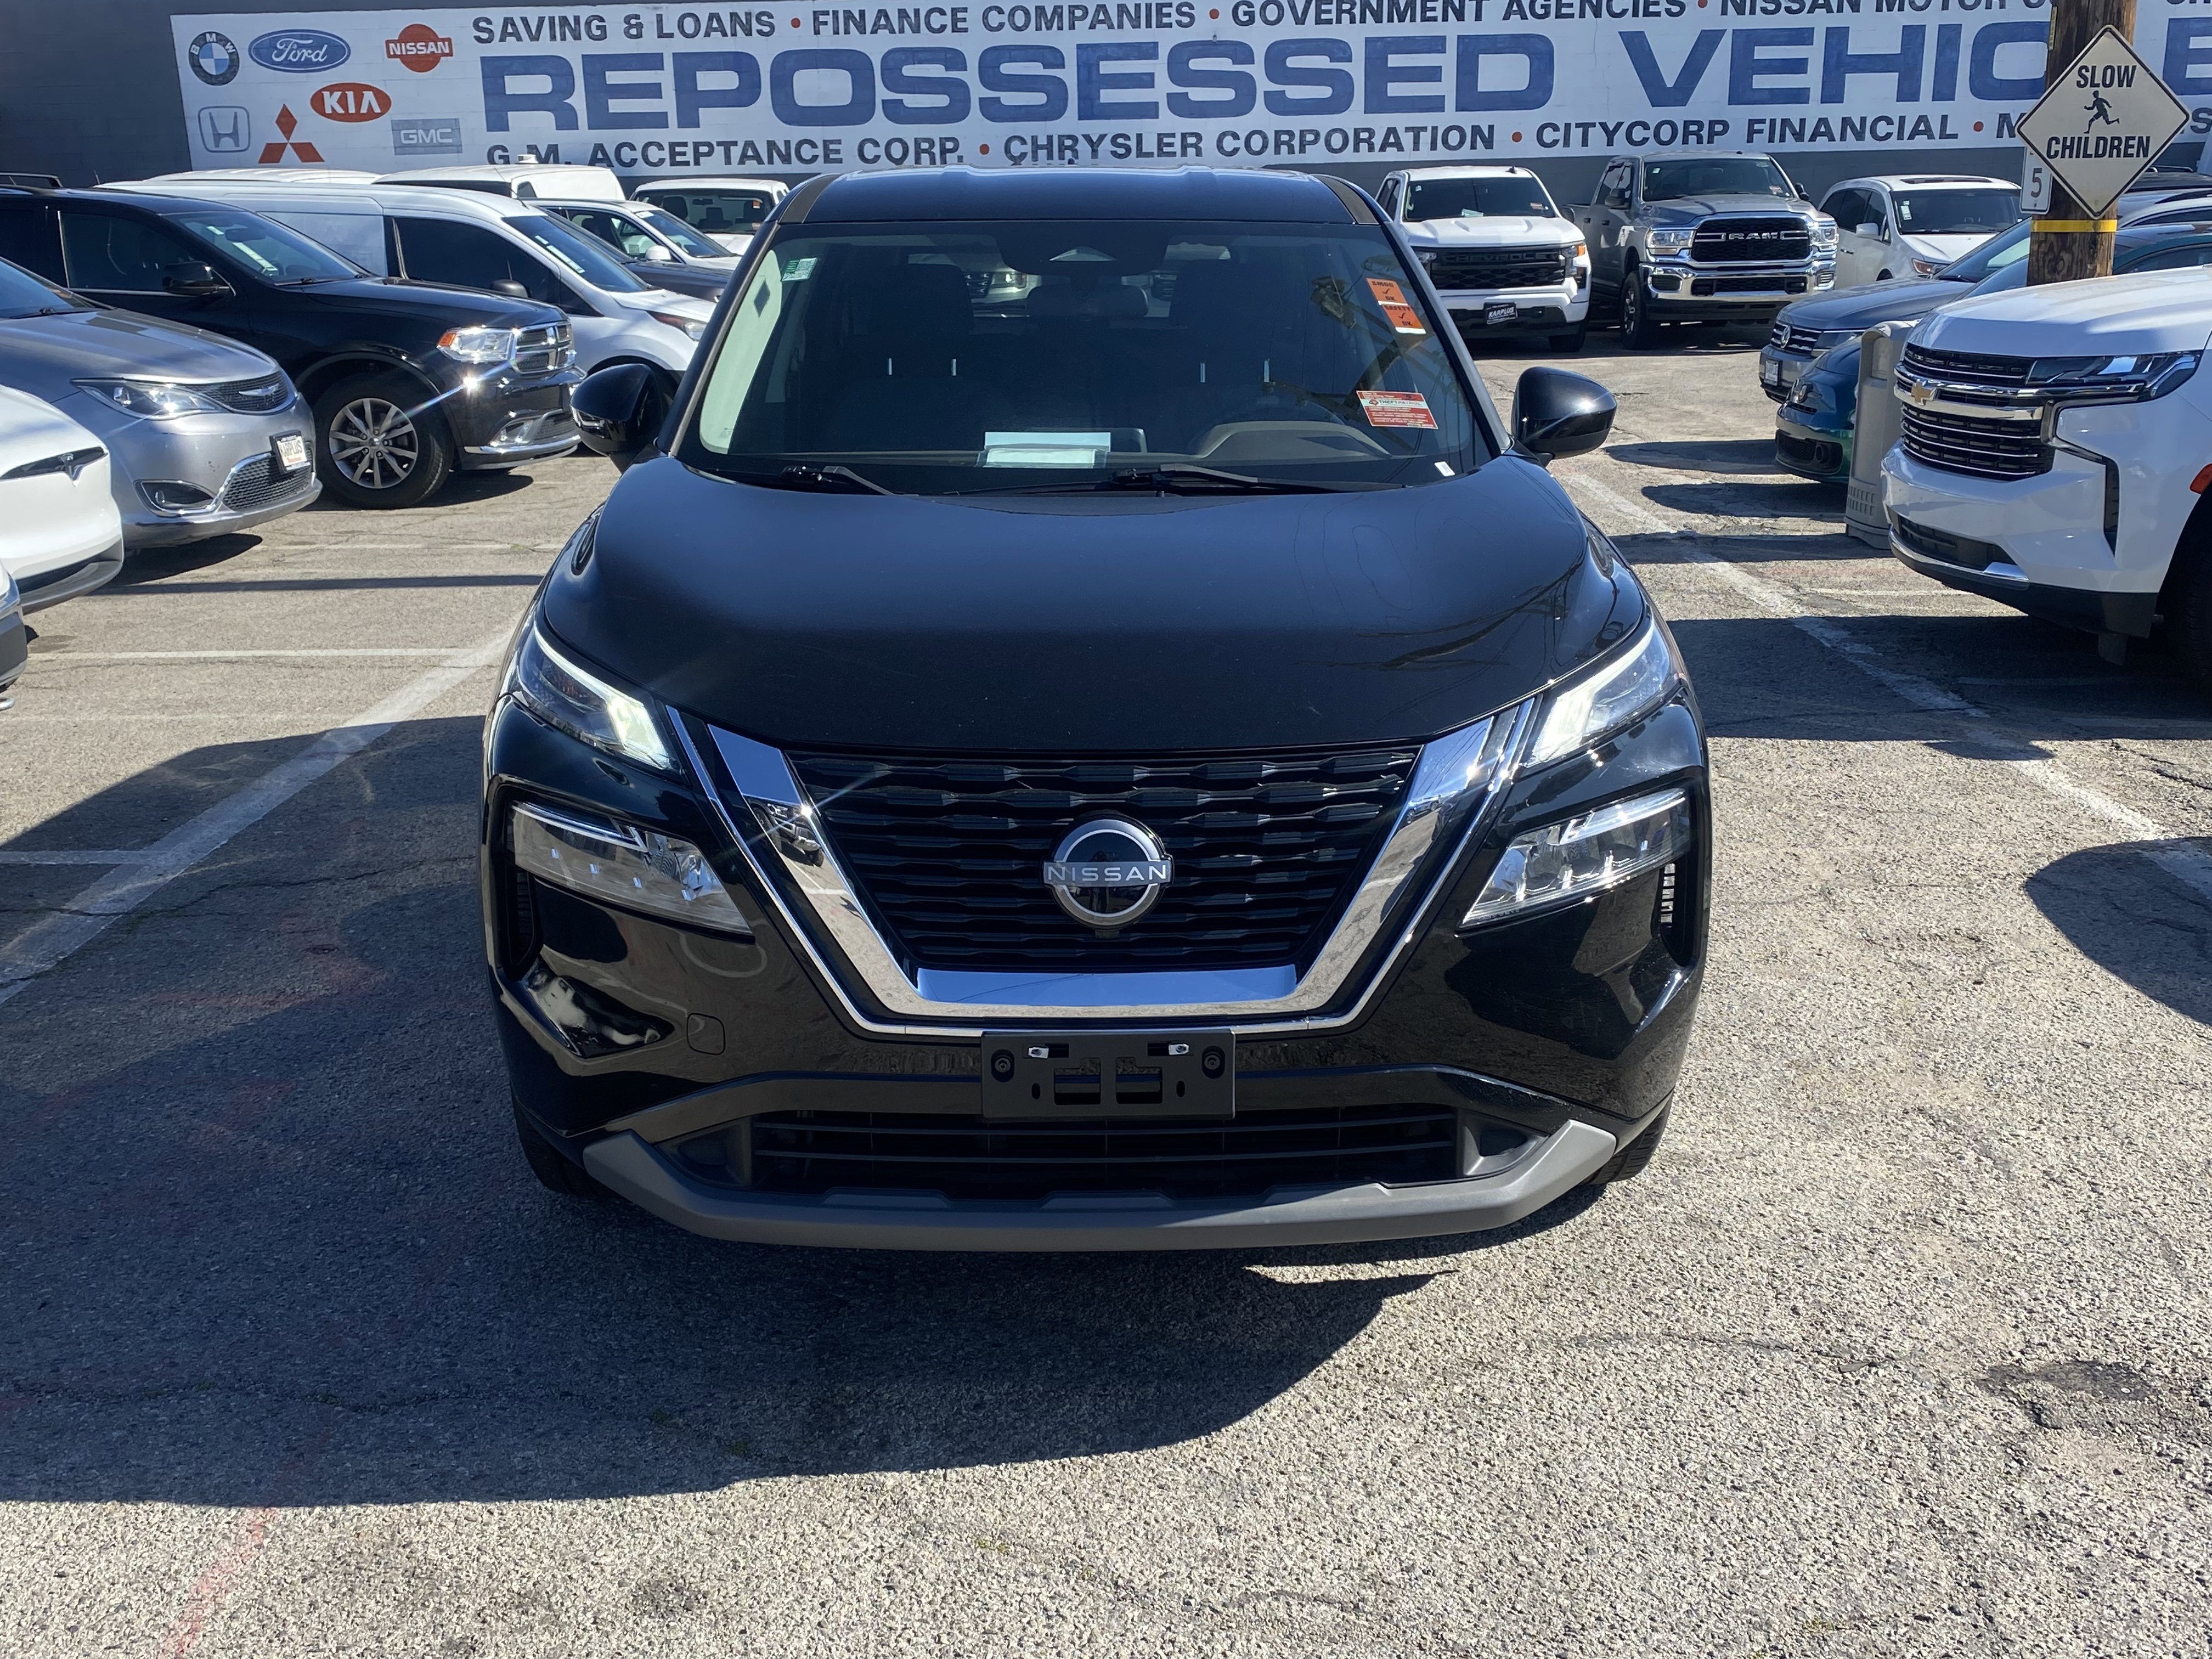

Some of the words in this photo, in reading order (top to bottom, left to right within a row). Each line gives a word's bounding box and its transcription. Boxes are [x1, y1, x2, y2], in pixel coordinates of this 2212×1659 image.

[472, 15, 607, 44] SAVING
[623, 14, 644, 39] &
[658, 11, 776, 39] LOANS
[812, 7, 969, 36] FINANCE
[982, 1, 1196, 33] COMPANIES
[1231, 0, 1486, 26] GOVERNMENT
[1503, 0, 1687, 20] AGENCIES
[190, 33, 236, 55] BMW
[272, 38, 328, 62] Ford
[389, 41, 449, 55] NISSAN
[481, 33, 1554, 132] REPOSSESSED
[2076, 65, 2137, 88] SLOW
[322, 91, 381, 114] KIA
[400, 128, 453, 144] GMC
[487, 144, 572, 165] GM.
[587, 139, 843, 167] ACCEPTANCE
[857, 137, 964, 165] CORP.
[1004, 132, 1203, 162] CHRYSLER
[1216, 125, 1494, 157] CORPORATION
[1536, 119, 1730, 148] CITYCORP
[1746, 114, 1960, 143] FINANCIAL
[2046, 136, 2151, 159] CHILDREN
[2031, 167, 2042, 198] 5
[1729, 232, 1778, 240] RAM
[1488, 307, 1514, 318] KARPLUS
[1047, 865, 1166, 882] NISSAN
